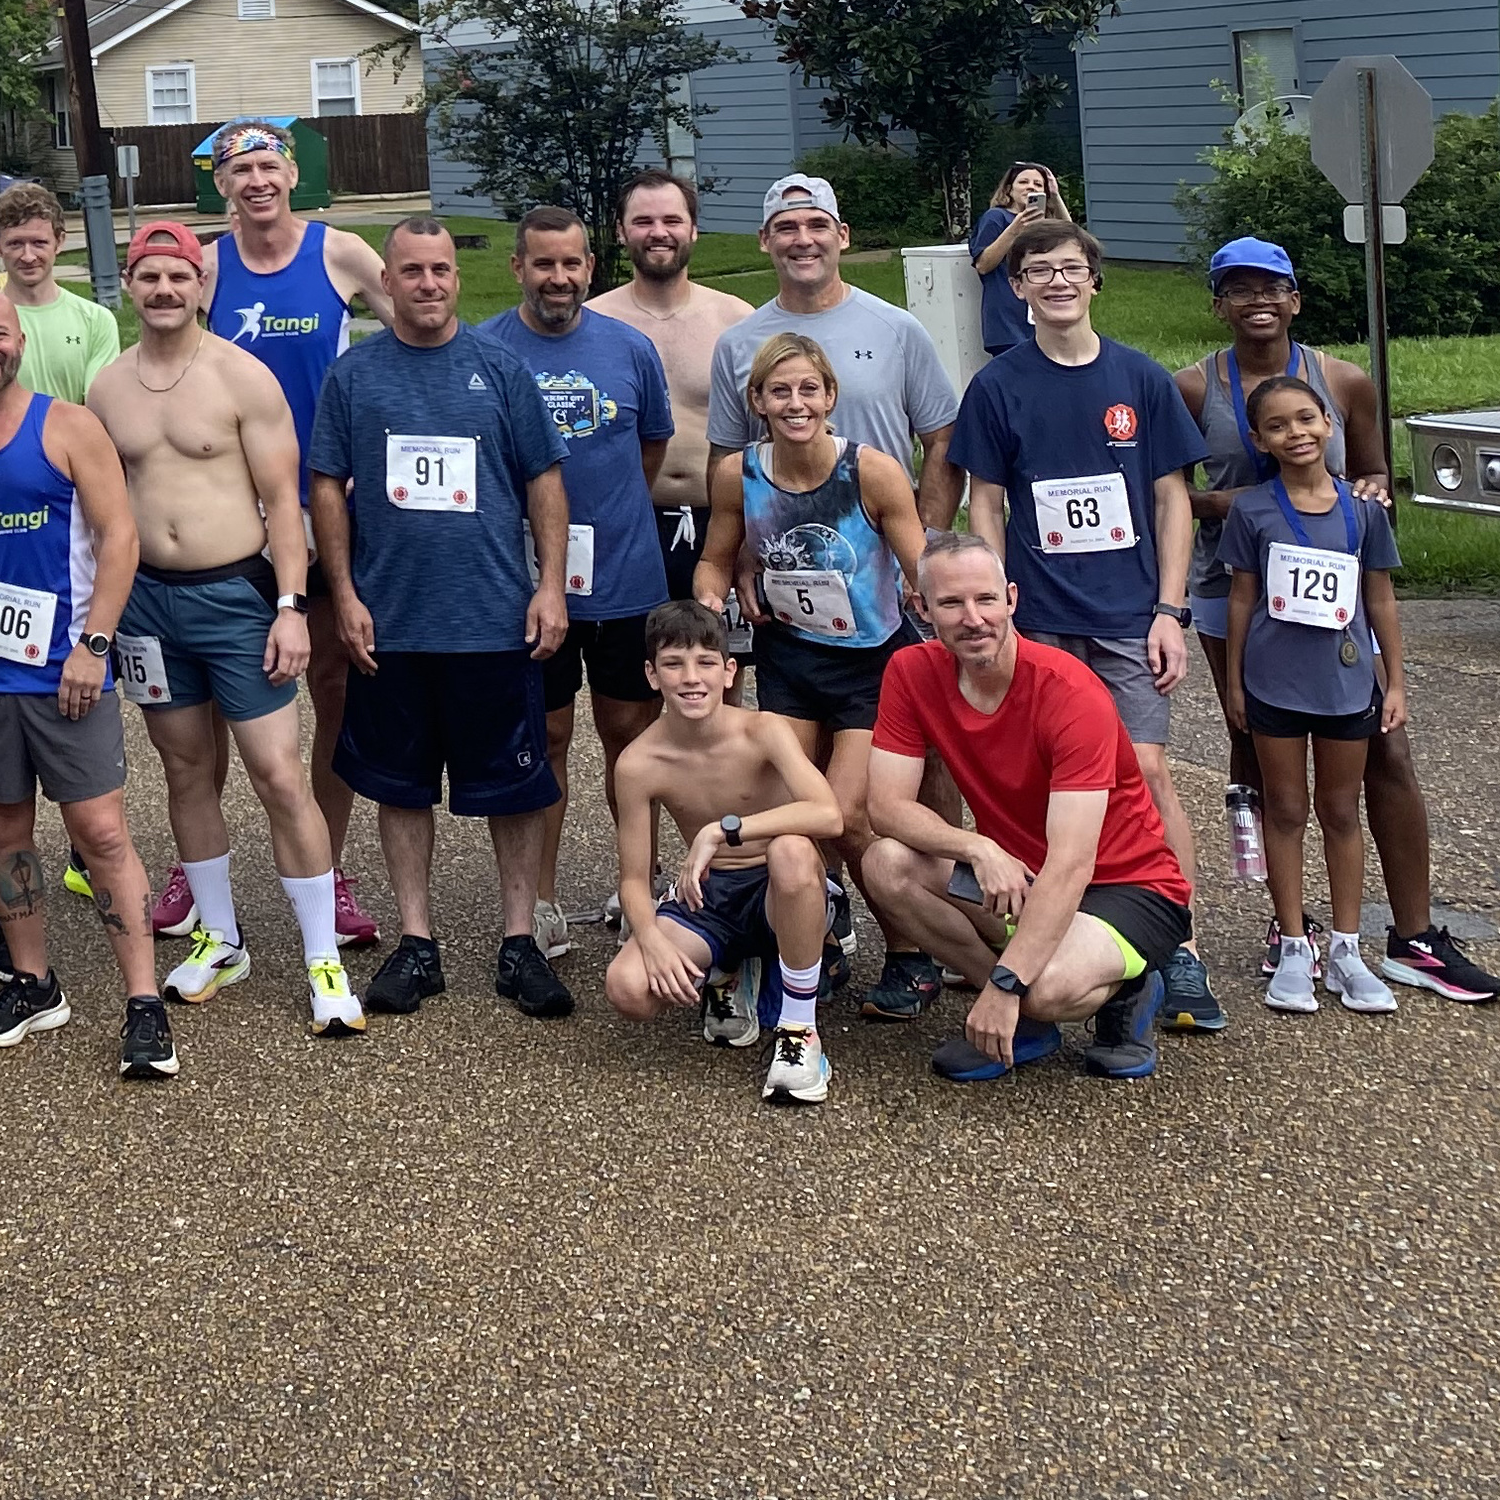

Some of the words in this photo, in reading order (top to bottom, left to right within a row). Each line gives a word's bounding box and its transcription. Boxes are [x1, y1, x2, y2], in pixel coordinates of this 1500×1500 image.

[262, 312, 320, 334] Tangi
[547, 401, 576, 409] CLASSIC
[401, 446, 443, 454] MEMORIAL
[415, 456, 444, 487] 91
[1047, 488, 1092, 497] MEMORIAL
[1094, 485, 1112, 494] RUN
[1066, 497, 1101, 529] 63
[1280, 554, 1327, 568] MEMORIAL
[1328, 562, 1346, 571] RUN
[1288, 567, 1338, 603] 129
[23, 599, 42, 609] RUN
[796, 588, 815, 616] 5
